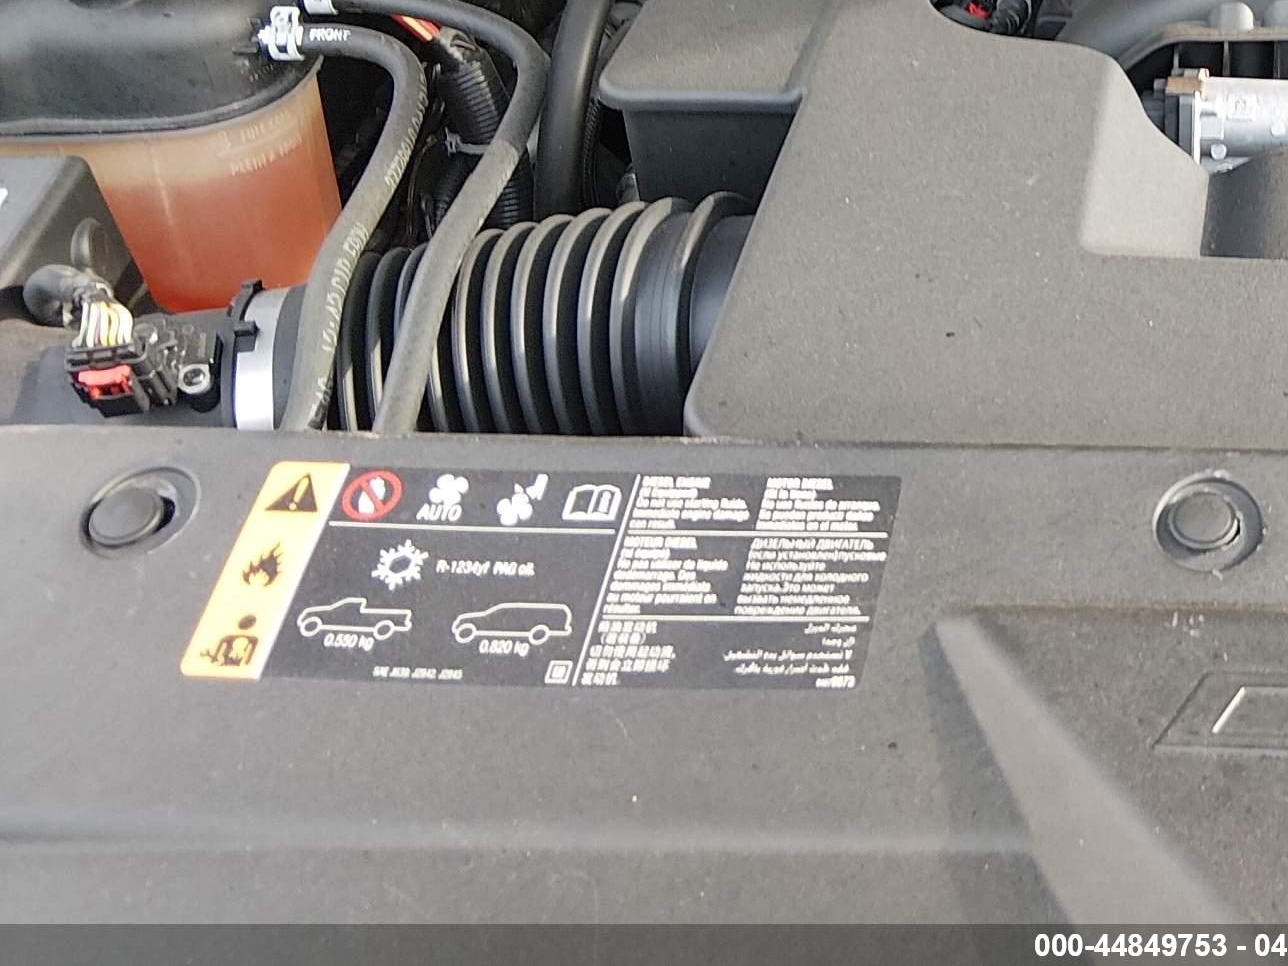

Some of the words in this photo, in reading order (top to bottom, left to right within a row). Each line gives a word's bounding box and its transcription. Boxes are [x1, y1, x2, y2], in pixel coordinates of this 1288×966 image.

[309, 27, 352, 42] FRONT
[416, 503, 462, 522] AUTO
[358, 635, 375, 652] kg
[514, 641, 530, 656] kg
